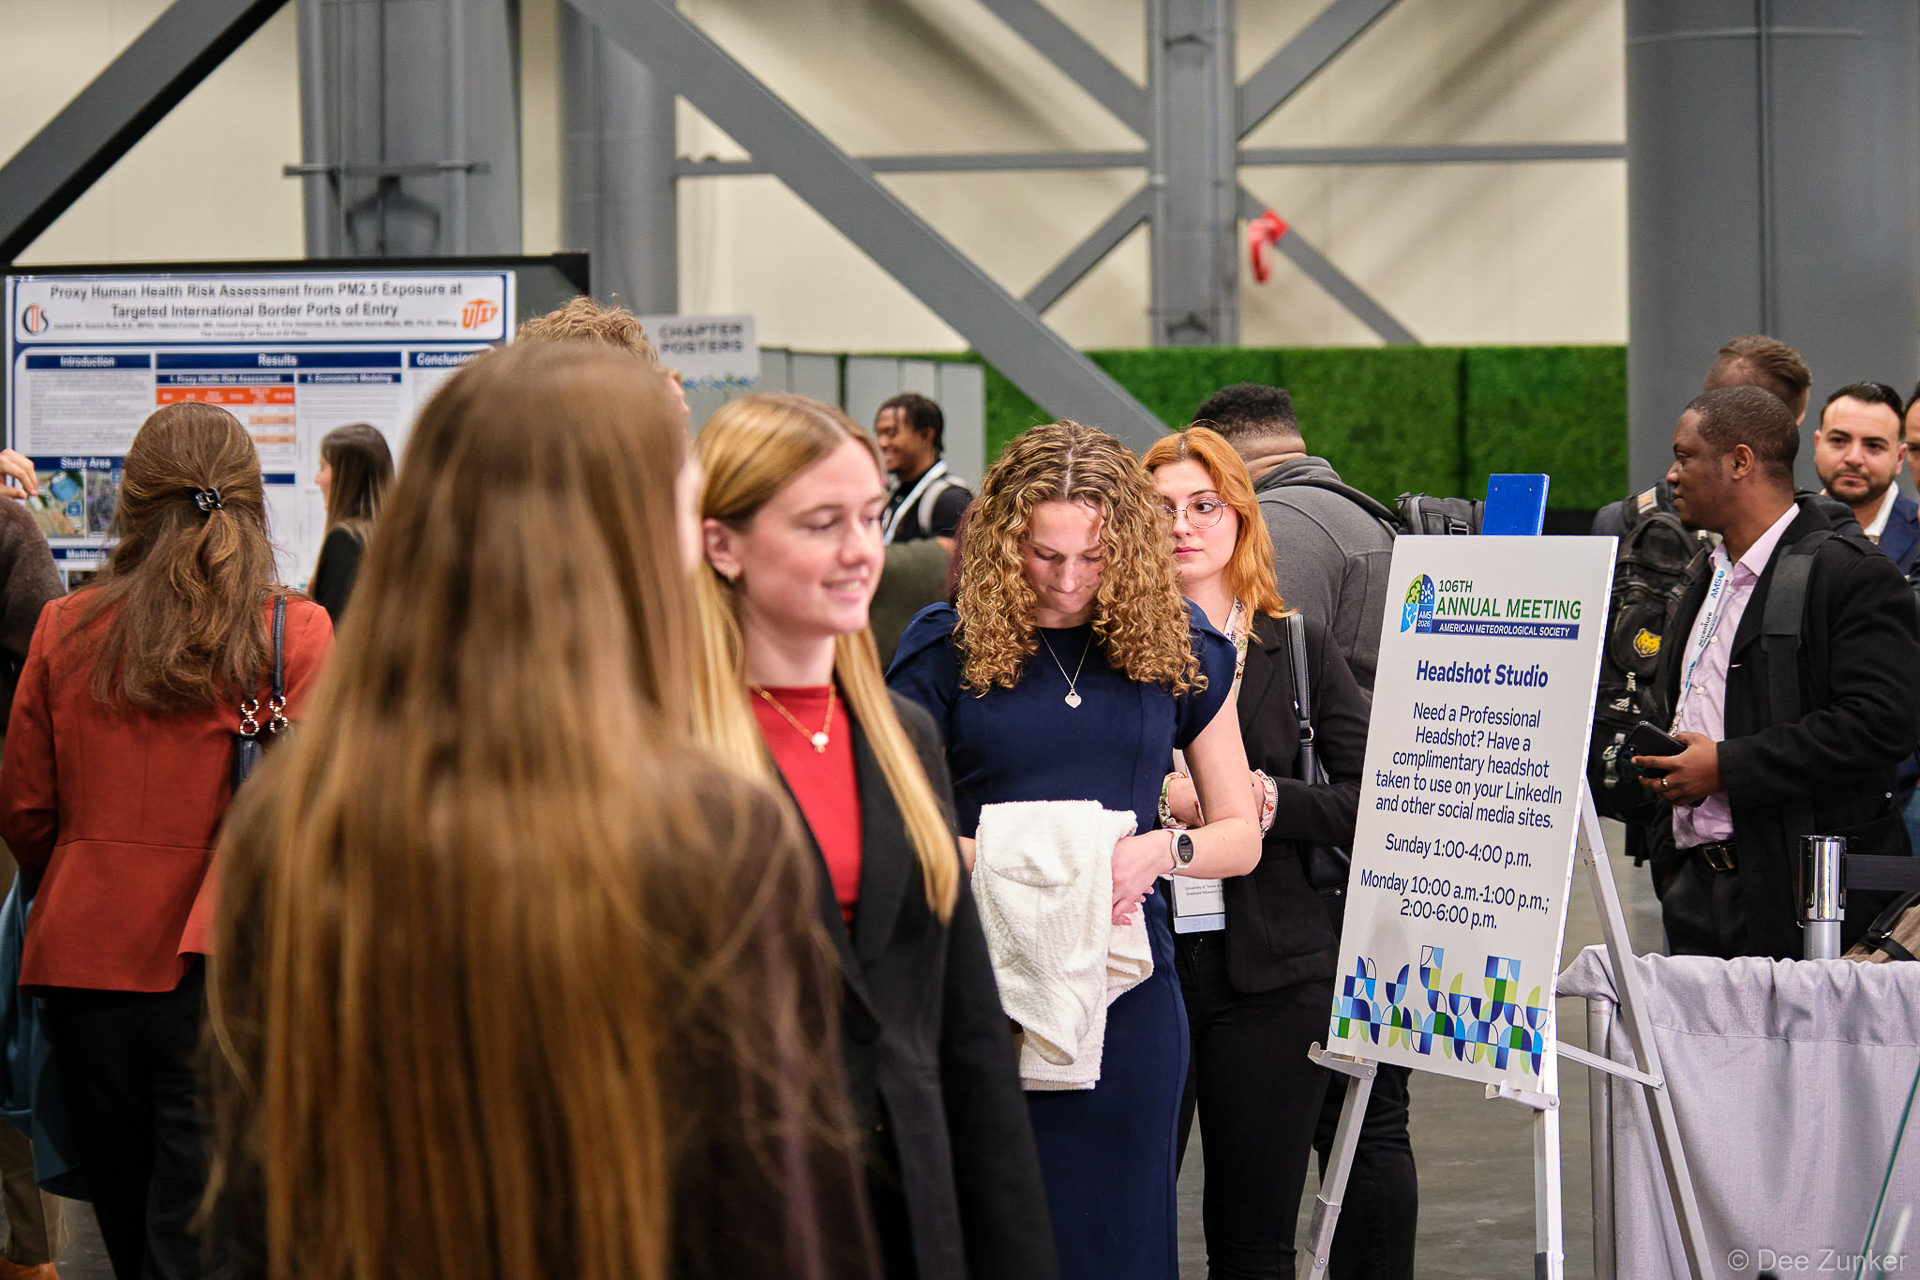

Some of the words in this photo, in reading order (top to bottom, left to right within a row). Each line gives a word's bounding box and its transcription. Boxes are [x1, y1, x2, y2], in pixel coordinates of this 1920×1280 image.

[50, 286, 87, 300] Proxy
[91, 285, 136, 298] Human
[141, 285, 182, 298] Health
[187, 284, 215, 297] Risk
[219, 283, 299, 297] Assessment
[304, 283, 333, 296] from
[338, 283, 377, 295] PM2.5
[382, 283, 445, 298] Exposure
[450, 283, 462, 295] at
[112, 305, 167, 320] Targeted
[171, 304, 254, 317] International
[258, 303, 301, 316] Border
[306, 303, 341, 316] Ports
[346, 303, 358, 315] of
[363, 303, 399, 318] Entry
[60, 355, 115, 367] Introduction
[258, 354, 298, 366] Results
[60, 457, 88, 470] Study
[89, 457, 111, 469] Area
[1438, 579, 1473, 593] 106TH
[1710, 577, 1723, 599] AMS
[1418, 610, 1432, 620] AMS
[1435, 596, 1501, 617] ANNUAL
[1505, 598, 1582, 620] MEETING
[1417, 619, 1431, 628] 2026
[1438, 622, 1475, 634] AMERICAN
[1475, 624, 1538, 636] METEOROLOGICAL
[1539, 627, 1570, 637] SOCIETY
[1416, 660, 1491, 685] Headshot
[1494, 664, 1549, 688] Studio
[1413, 701, 1447, 721] Need
[1449, 708, 1456, 722] a
[1459, 705, 1541, 728] Professional
[1415, 726, 1485, 748] Headshot?
[1486, 731, 1520, 751] Have
[1522, 738, 1531, 752] a
[1392, 749, 1485, 777] complimentary
[1487, 755, 1550, 778] headshot
[1375, 769, 1410, 790] taken
[1413, 773, 1427, 791] to
[1429, 778, 1452, 793] use
[1455, 781, 1471, 795] on
[1473, 782, 1504, 801] your
[1505, 781, 1562, 805] LinkedIn
[1375, 794, 1399, 812] and
[1401, 796, 1436, 816] other
[1437, 801, 1474, 821] social
[1475, 805, 1515, 825] media
[1518, 807, 1554, 829] sites.
[1385, 833, 1432, 859] Sunday
[1433, 839, 1503, 864] 1:00-4:00
[1504, 850, 1532, 869] p.m.
[1360, 869, 1408, 896] Monday
[1410, 875, 1451, 897] 10:00
[1453, 884, 1516, 906] a.m.-1:00
[1517, 893, 1550, 914] p.m.;
[1400, 898, 1469, 925] 2:00-6:00
[1470, 911, 1497, 930] p.m.
